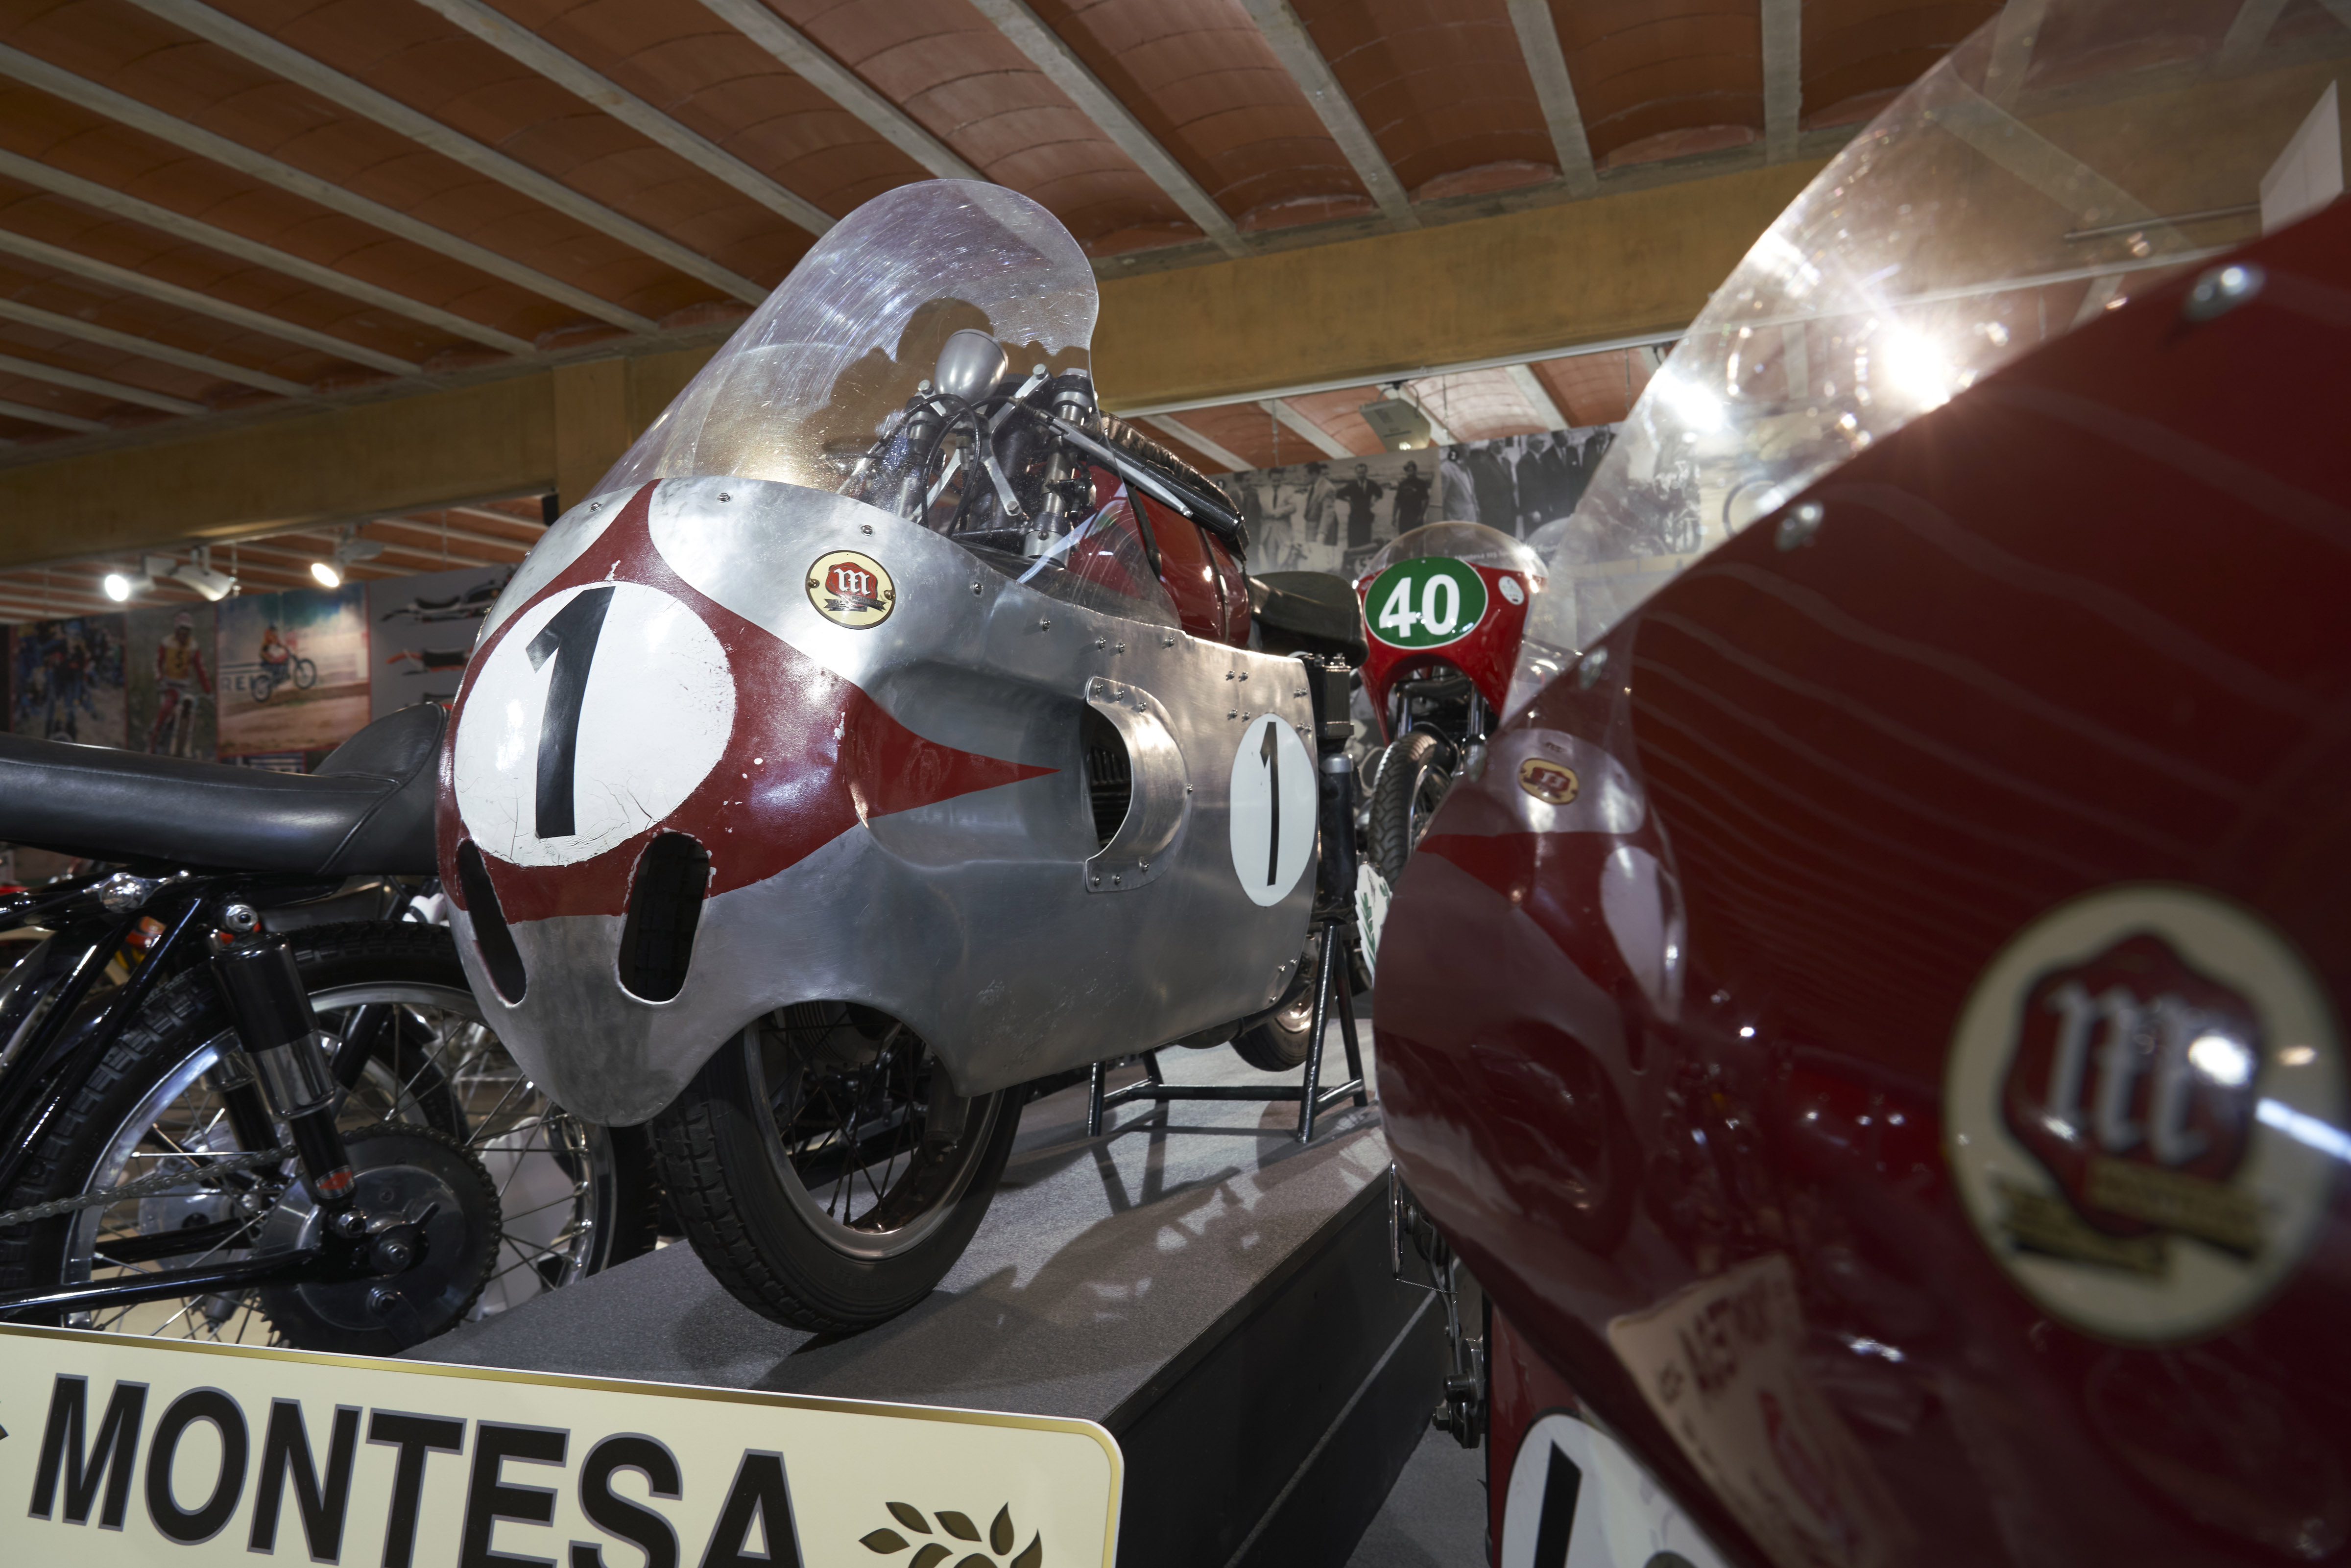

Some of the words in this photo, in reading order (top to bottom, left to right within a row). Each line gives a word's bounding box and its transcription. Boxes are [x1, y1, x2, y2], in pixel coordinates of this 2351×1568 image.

[1379, 574, 1460, 638] 40
[526, 586, 616, 839] 1
[1260, 721, 1280, 886] 1
[27, 1372, 805, 1568] MONTESA
